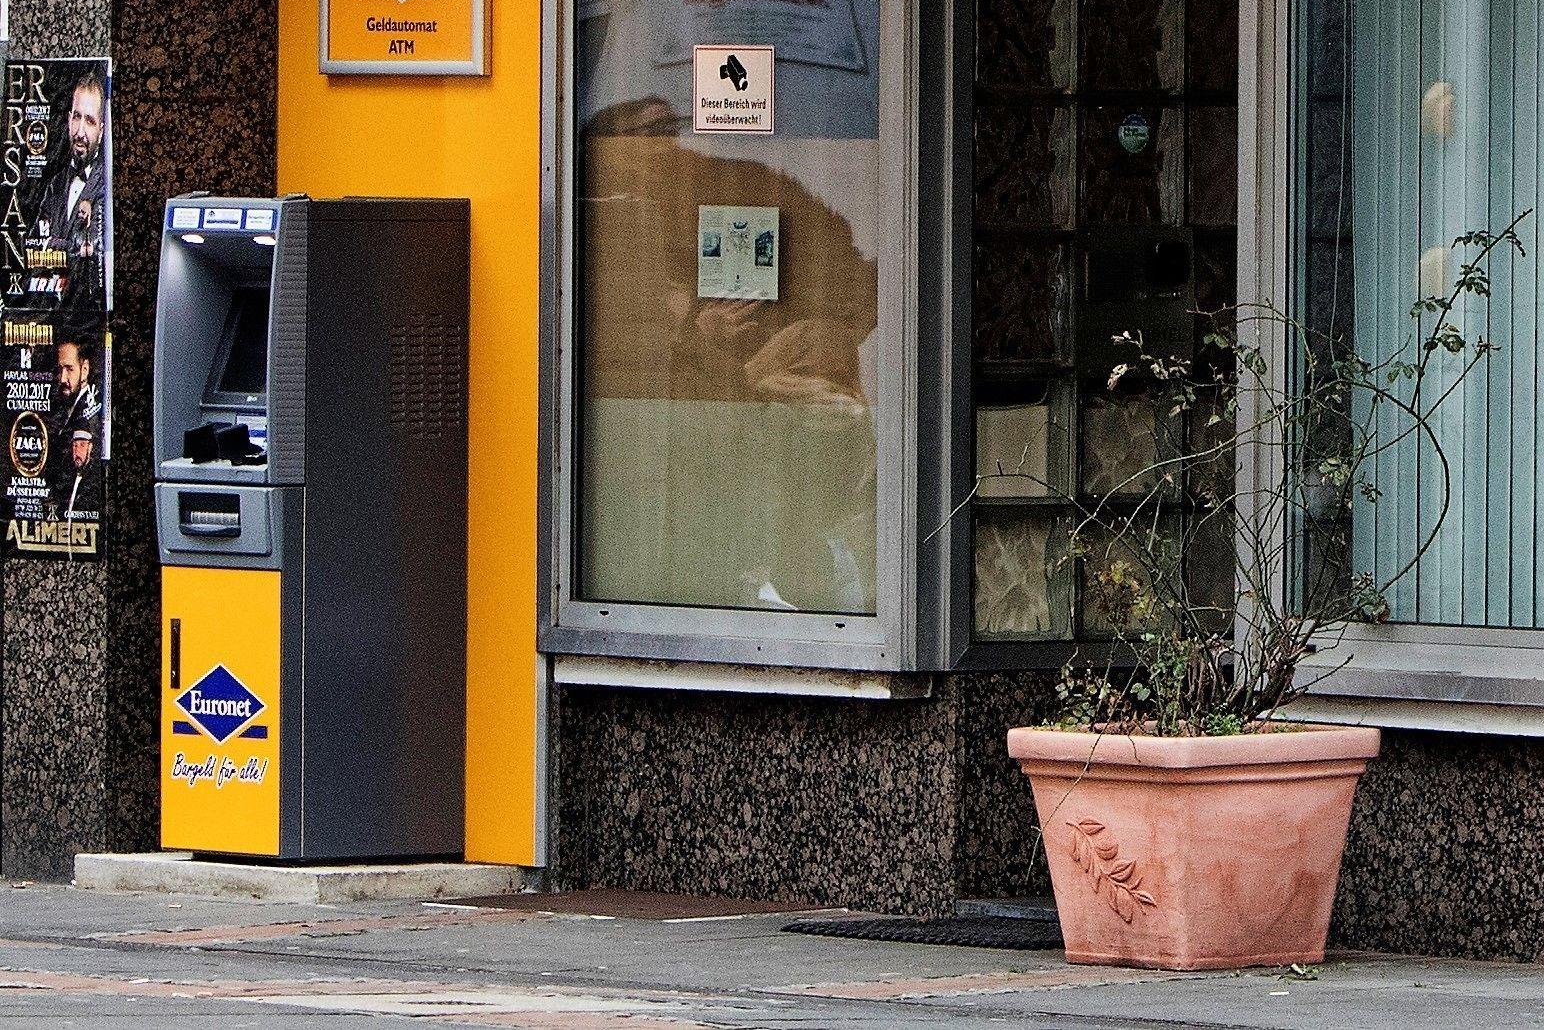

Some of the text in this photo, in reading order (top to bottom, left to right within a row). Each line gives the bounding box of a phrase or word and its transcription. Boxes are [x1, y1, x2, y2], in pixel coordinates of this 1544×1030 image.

[366, 17, 437, 32] Geldautomat
[388, 40, 414, 54] ATM
[701, 97, 767, 110] Dieser Bereich wird
[705, 114, 762, 126] videoüberwacht!
[189, 690, 252, 718] Euronet
[172, 753, 268, 787] Bargeld für alle!
